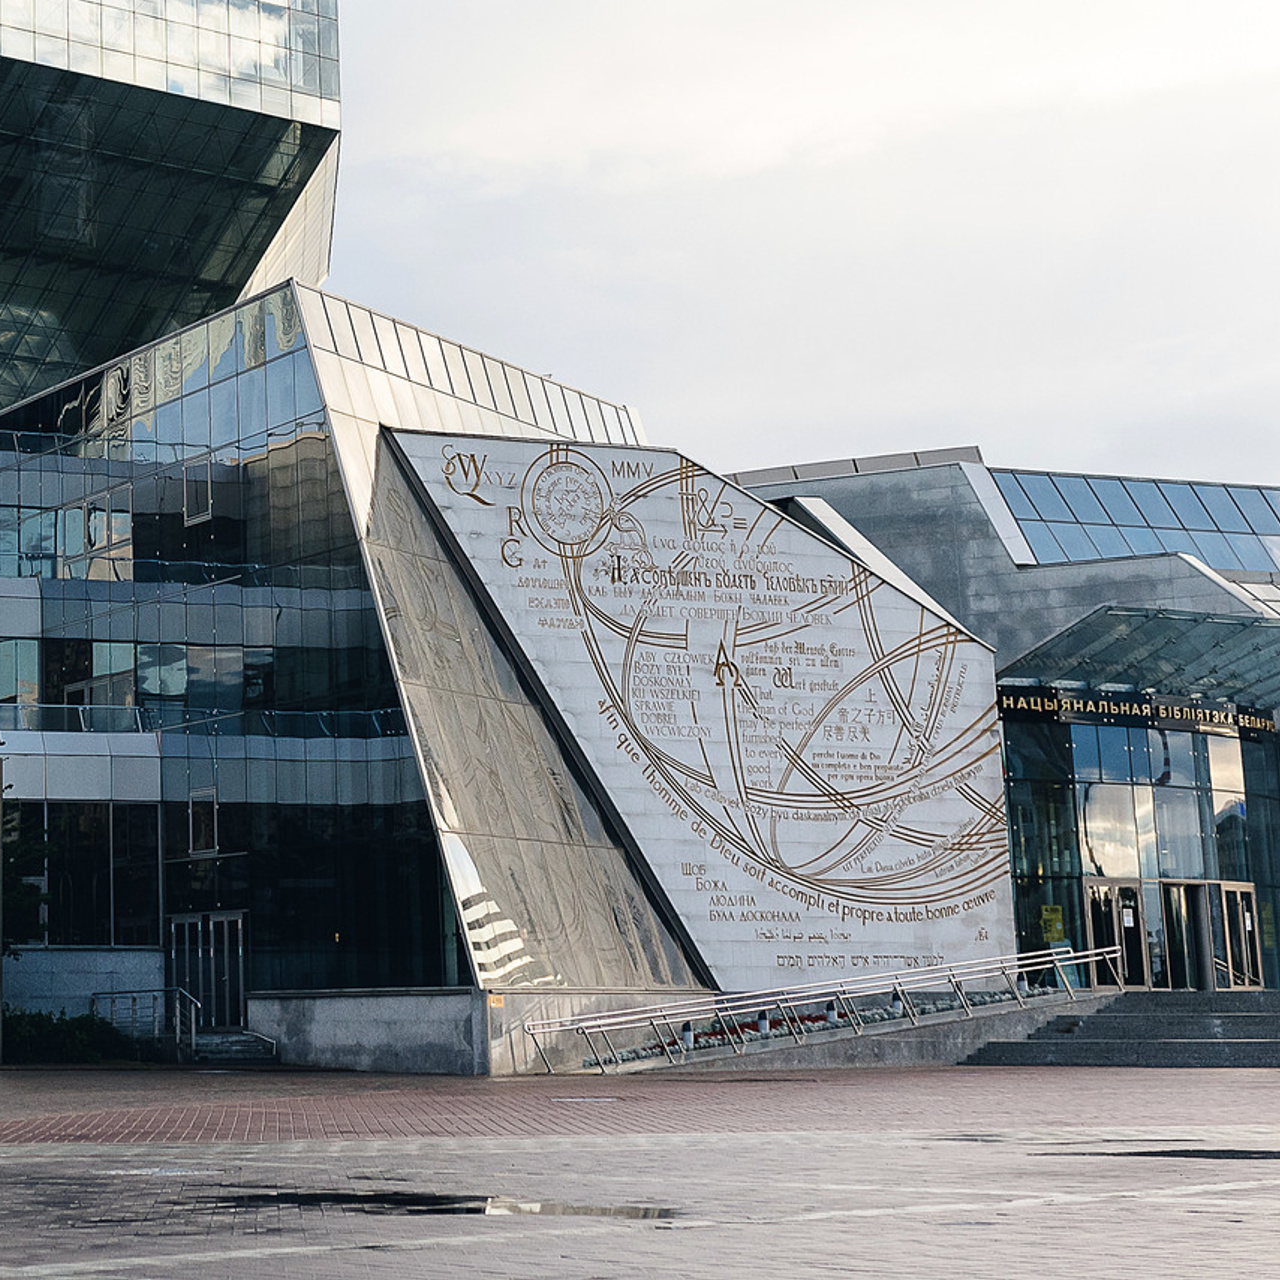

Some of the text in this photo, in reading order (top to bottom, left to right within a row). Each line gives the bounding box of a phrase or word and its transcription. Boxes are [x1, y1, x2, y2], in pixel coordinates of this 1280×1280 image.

[611, 460, 654, 479] MMV
[483, 470, 517, 487] XYZ
[506, 505, 528, 537] R
[679, 606, 737, 620] СОВЕРШЕН
[785, 611, 832, 625] ЧЕЛОВЕК
[638, 651, 657, 663] ABY
[751, 685, 774, 700] That
[864, 688, 877, 703] 上
[634, 700, 675, 712] SPRAWIE
[778, 702, 788, 715] of
[791, 702, 814, 716] God
[1002, 695, 1152, 718] НАЦЫЯНАЛЬНАЯ
[1158, 705, 1234, 726] БІБЛІЯТЭКА
[739, 720, 758, 732] may
[745, 747, 784, 762] to every
[746, 760, 771, 776] good
[749, 775, 775, 788] work
[597, 699, 621, 731] afin
[616, 731, 641, 765] que
[690, 818, 708, 839] de
[708, 832, 741, 867] Dieu
[742, 862, 767, 883] soit
[767, 876, 824, 912] accompli
[827, 898, 840, 915] et
[841, 904, 885, 926] propre
[893, 906, 924, 923] toute
[924, 904, 960, 920] bonne
[708, 894, 757, 907] ЛЮДИНА
[708, 909, 801, 922] БУЛА ДОСКОНАЛА
